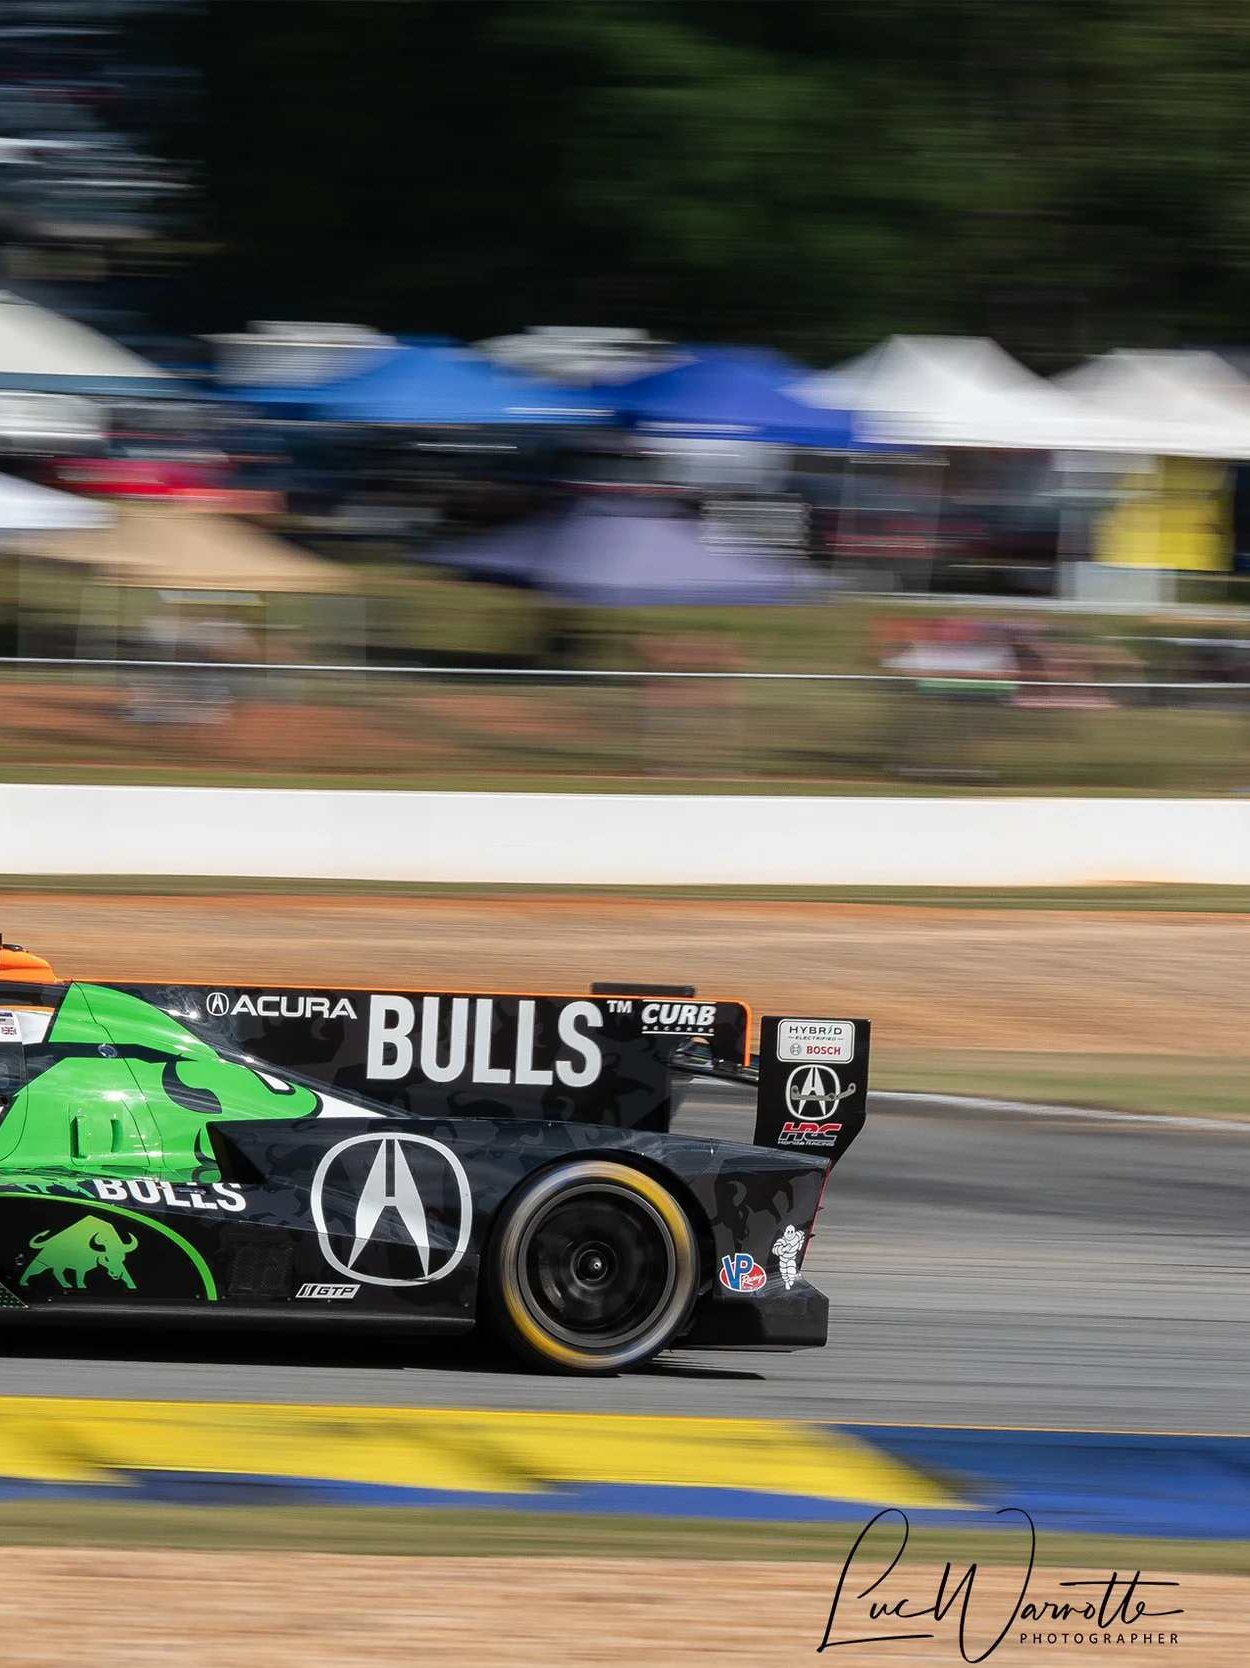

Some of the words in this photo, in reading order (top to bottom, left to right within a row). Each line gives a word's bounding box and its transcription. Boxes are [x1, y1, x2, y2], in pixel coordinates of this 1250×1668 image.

[641, 1003, 717, 1026] CURB
[230, 994, 358, 1020] ACURA
[366, 994, 604, 1088] BULLS
[788, 1025, 843, 1036] HYBRID
[806, 1045, 842, 1056] BOSCH
[778, 1122, 843, 1142] HRC
[92, 1179, 248, 1212] BULLS
[721, 1253, 755, 1292] VP
[316, 1286, 355, 1296] GTP
